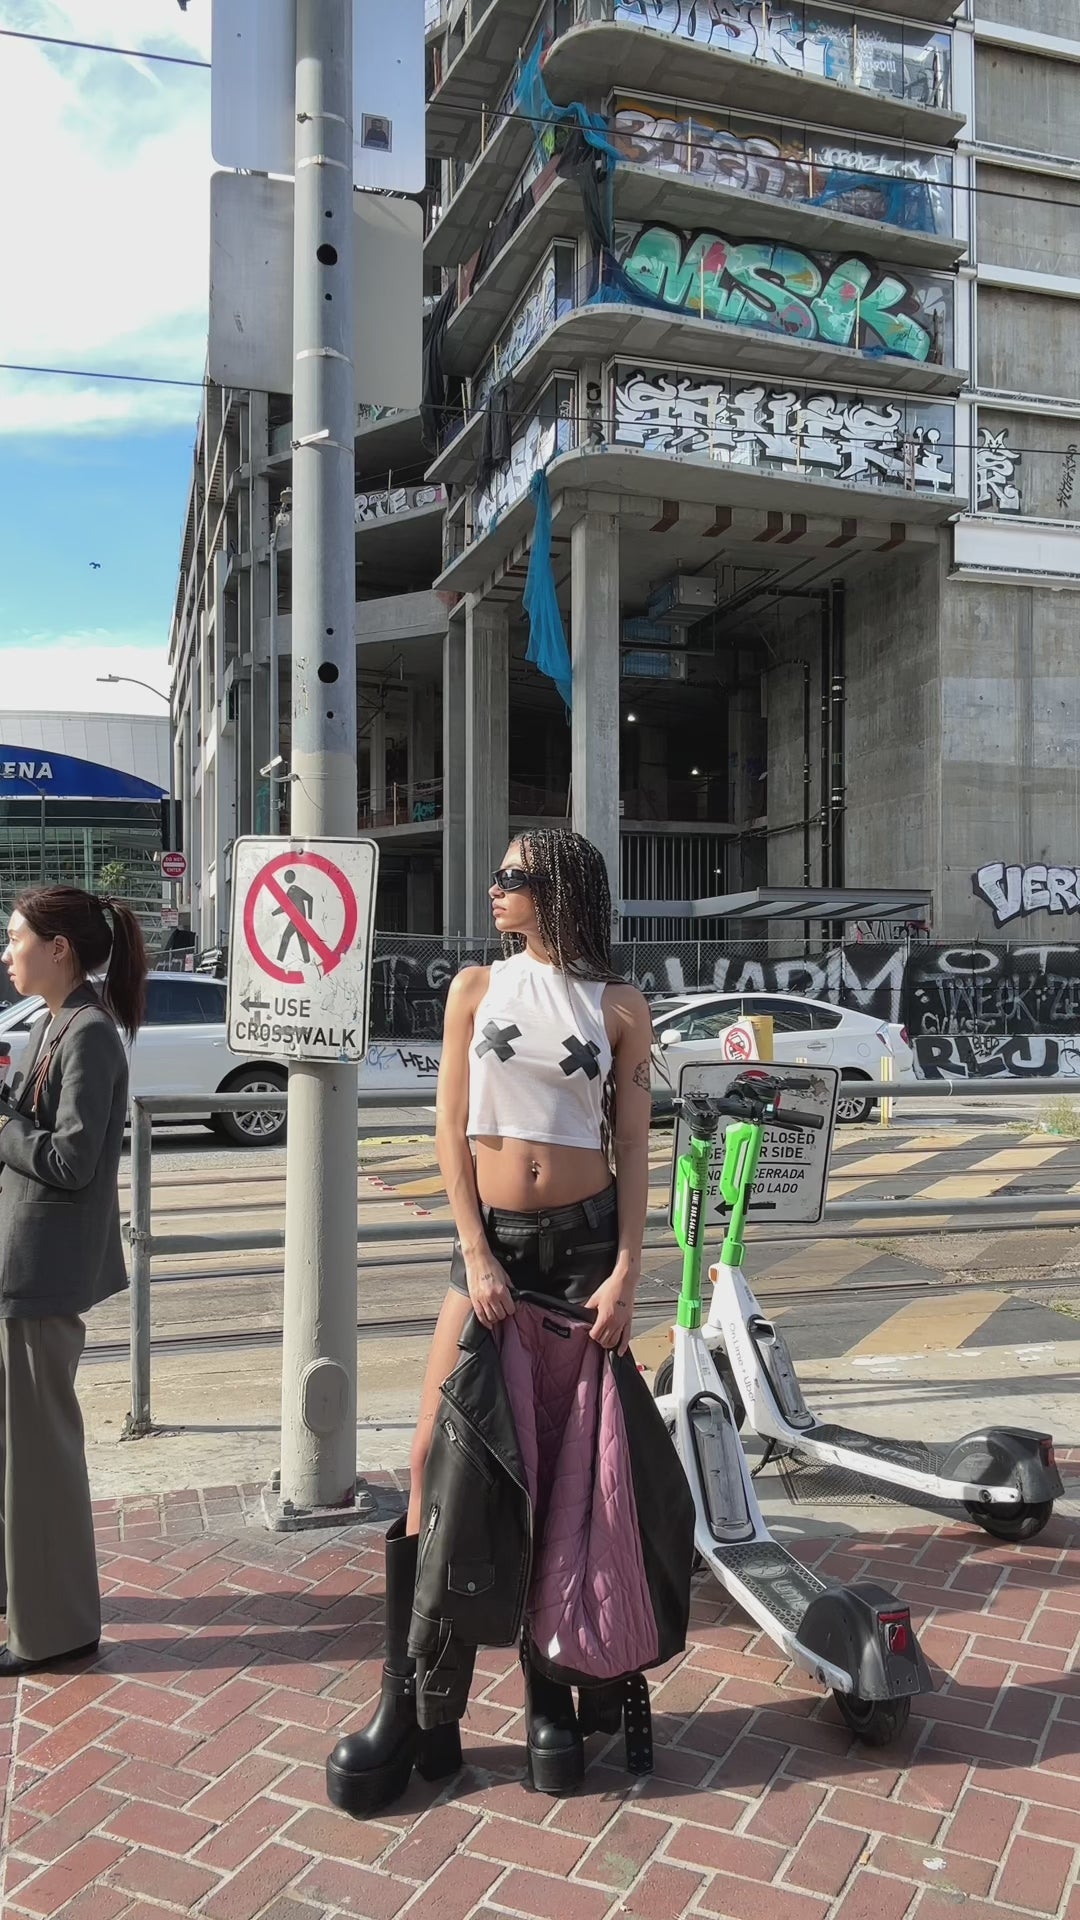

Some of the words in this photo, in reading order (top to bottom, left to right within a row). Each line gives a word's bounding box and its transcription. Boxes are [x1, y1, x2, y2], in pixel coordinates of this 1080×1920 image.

[972, 862, 1080, 929] VER
[274, 997, 311, 1018] USE
[236, 1021, 357, 1048] CROSSWALK
[762, 1131, 816, 1145] CLOSED
[771, 1146, 804, 1158] SIDE
[767, 1183, 798, 1193] LADO
